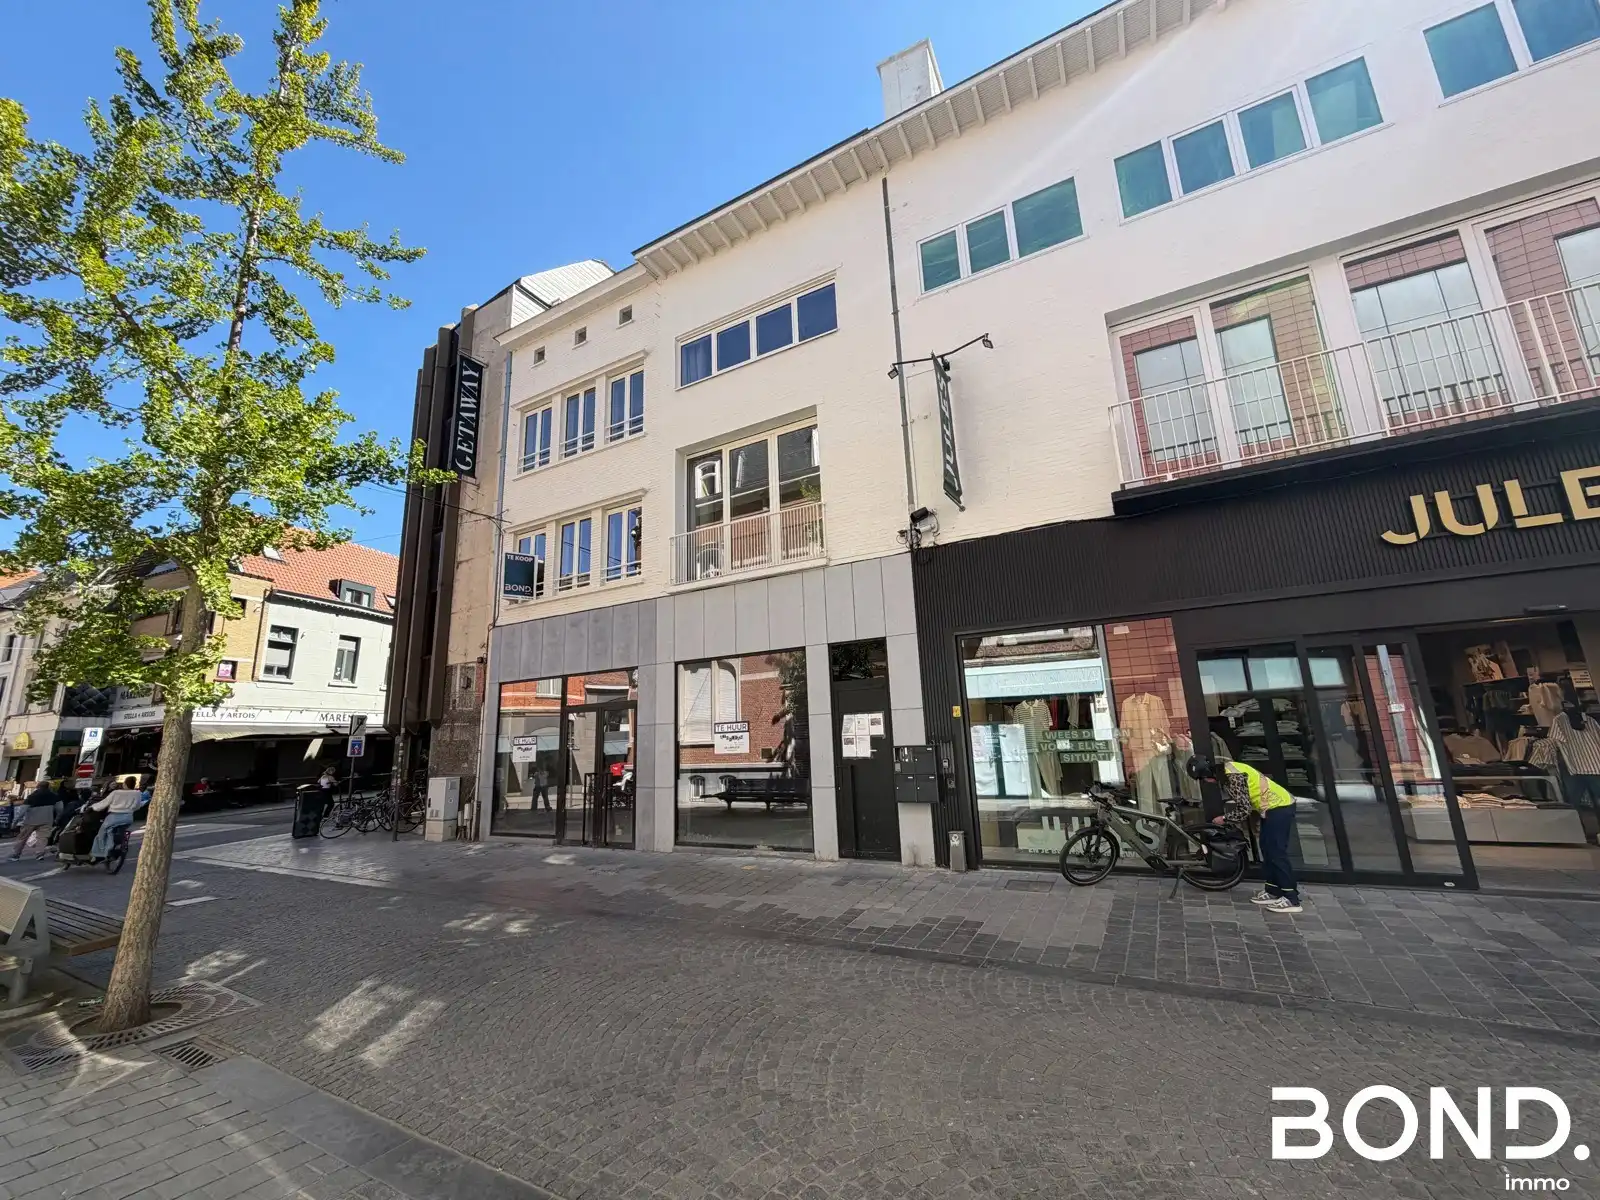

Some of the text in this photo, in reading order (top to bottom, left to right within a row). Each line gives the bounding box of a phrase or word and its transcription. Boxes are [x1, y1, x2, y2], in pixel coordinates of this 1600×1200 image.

[455, 361, 479, 471] GETAWAY
[937, 371, 959, 491] JULES
[515, 555, 533, 563] KOOP
[726, 723, 747, 731] HUUR
[1045, 730, 1078, 740] WEES
[1040, 740, 1107, 751] VOR ELKE
[1062, 751, 1117, 762] SITUATI
